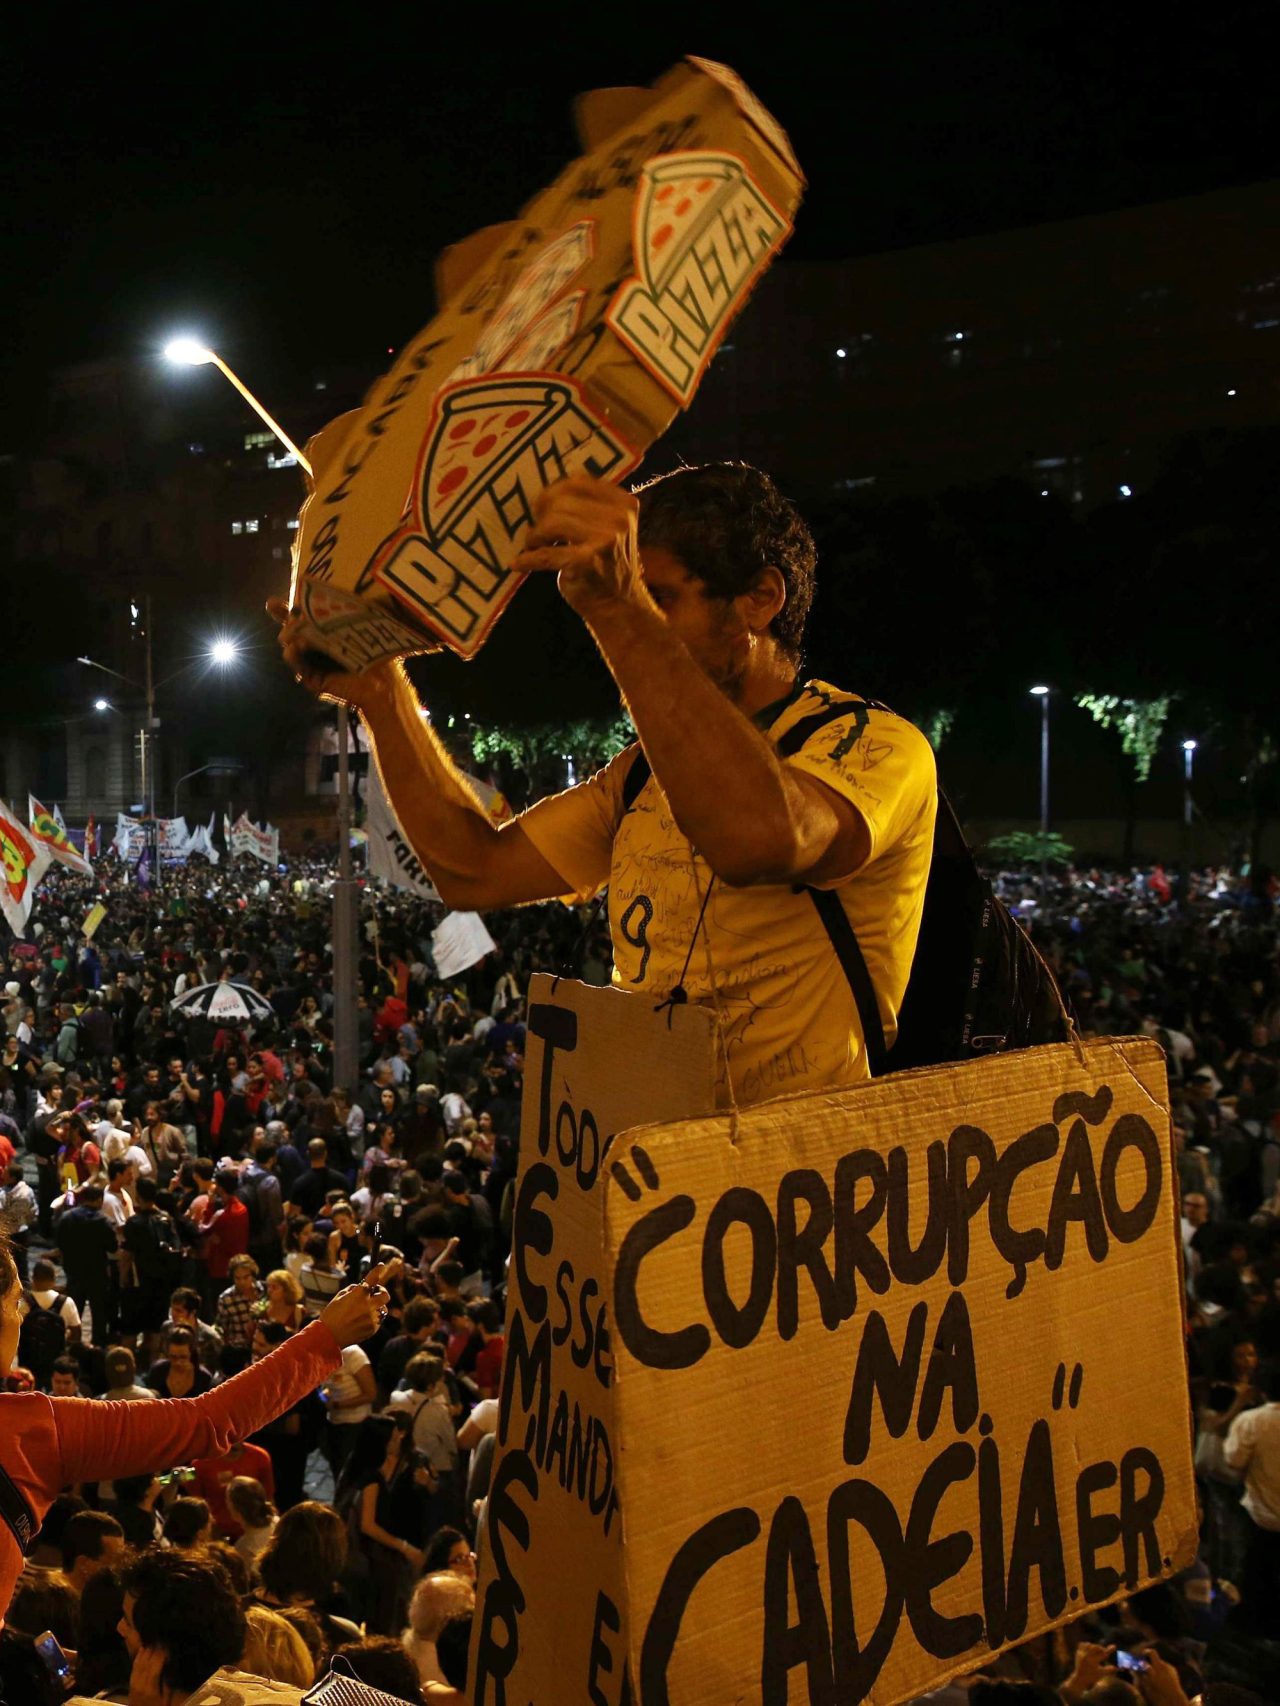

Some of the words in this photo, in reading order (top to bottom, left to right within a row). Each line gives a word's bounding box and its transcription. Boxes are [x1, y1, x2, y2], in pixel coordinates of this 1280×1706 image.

[616, 180, 787, 391] PIZZA
[384, 405, 624, 641] PIZZA
[843, 1291, 981, 1465] NA
